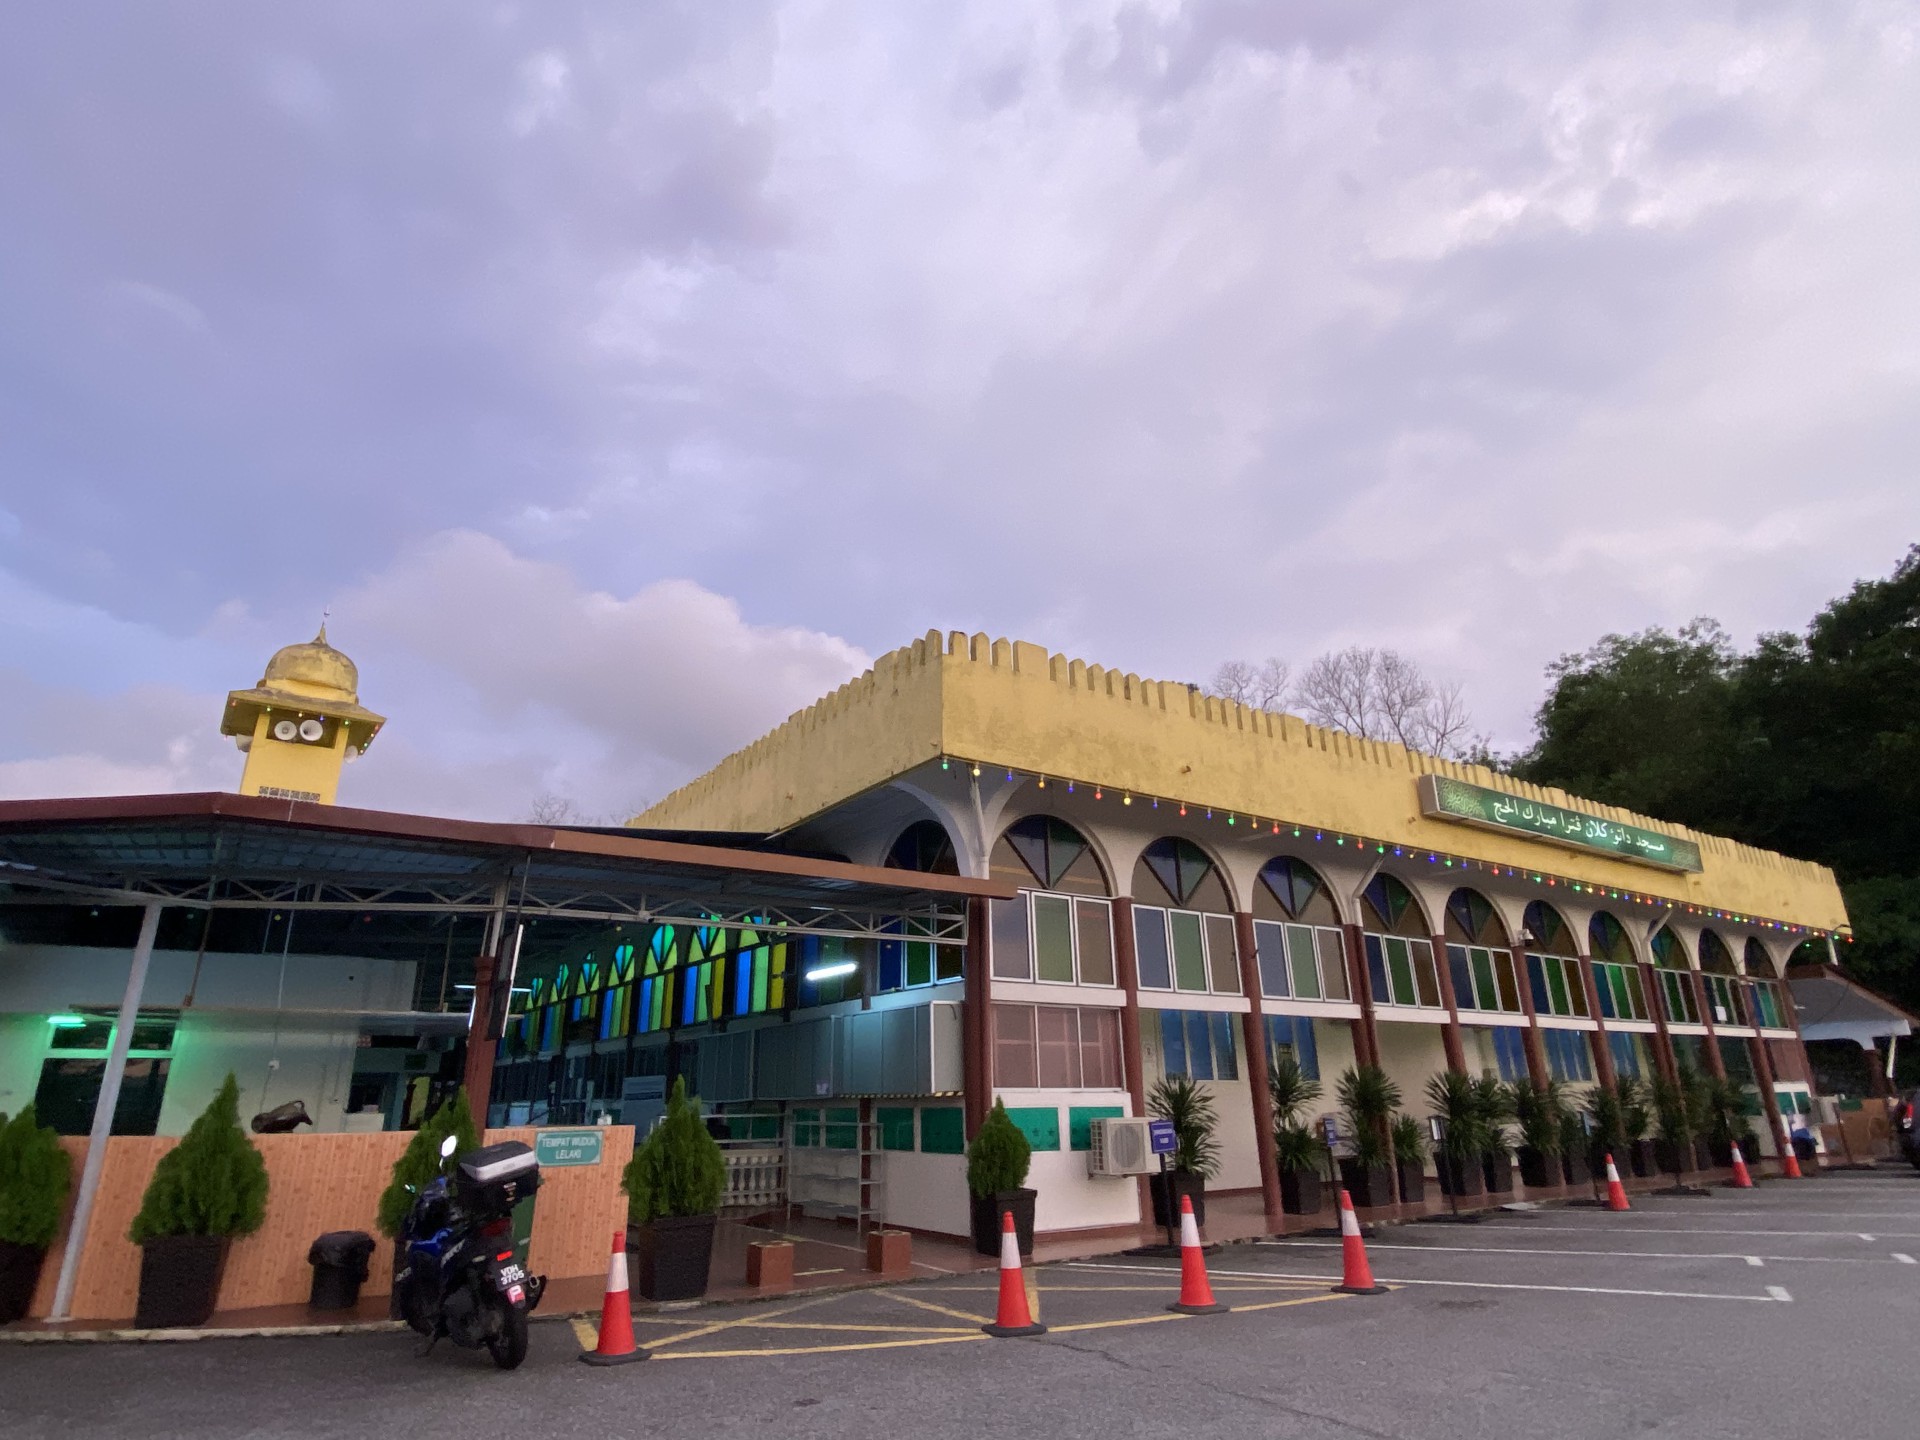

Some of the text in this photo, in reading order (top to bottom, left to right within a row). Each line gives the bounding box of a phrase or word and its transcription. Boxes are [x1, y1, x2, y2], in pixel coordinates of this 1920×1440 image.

[1522, 804, 1557, 830] مبارك
[1636, 835, 1664, 852] مسجد
[542, 1137, 570, 1148] TEMPAT
[555, 1149, 582, 1160] LELAKI
